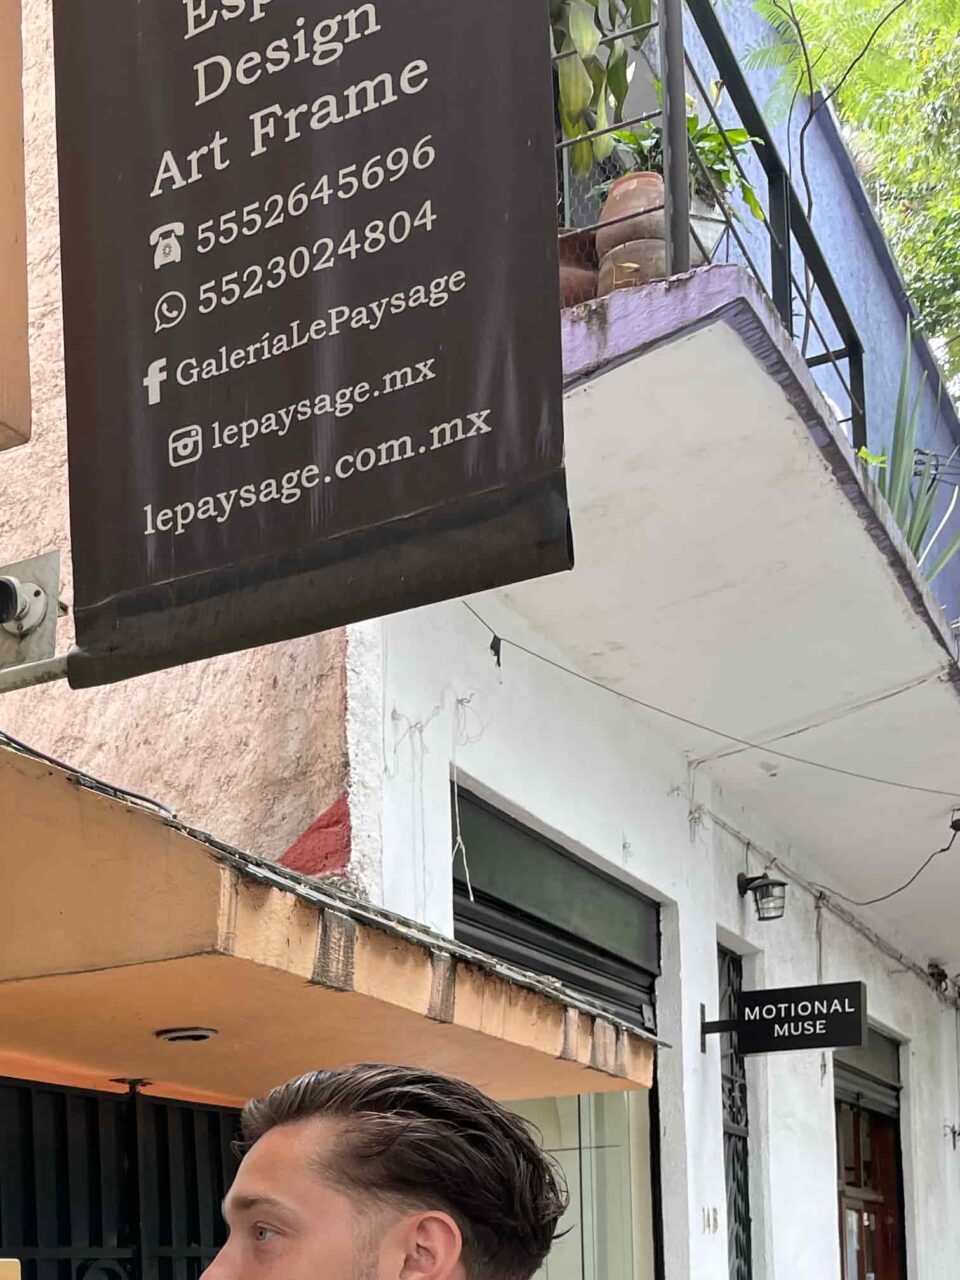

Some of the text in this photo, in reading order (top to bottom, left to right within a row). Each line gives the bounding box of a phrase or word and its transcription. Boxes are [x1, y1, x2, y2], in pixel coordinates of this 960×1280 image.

[192, 3, 382, 107] Design
[150, 58, 429, 198] Art Frame
[196, 134, 436, 254] 5552645696
[197, 199, 438, 314] 5523024804
[175, 269, 467, 387] GaleríaLePaysage
[211, 357, 437, 449] lepaysage.mx
[143, 408, 493, 536] lepaysage.com.mx
[745, 998, 855, 1020] MOTIONAL
[774, 1020, 826, 1037] MUSE
